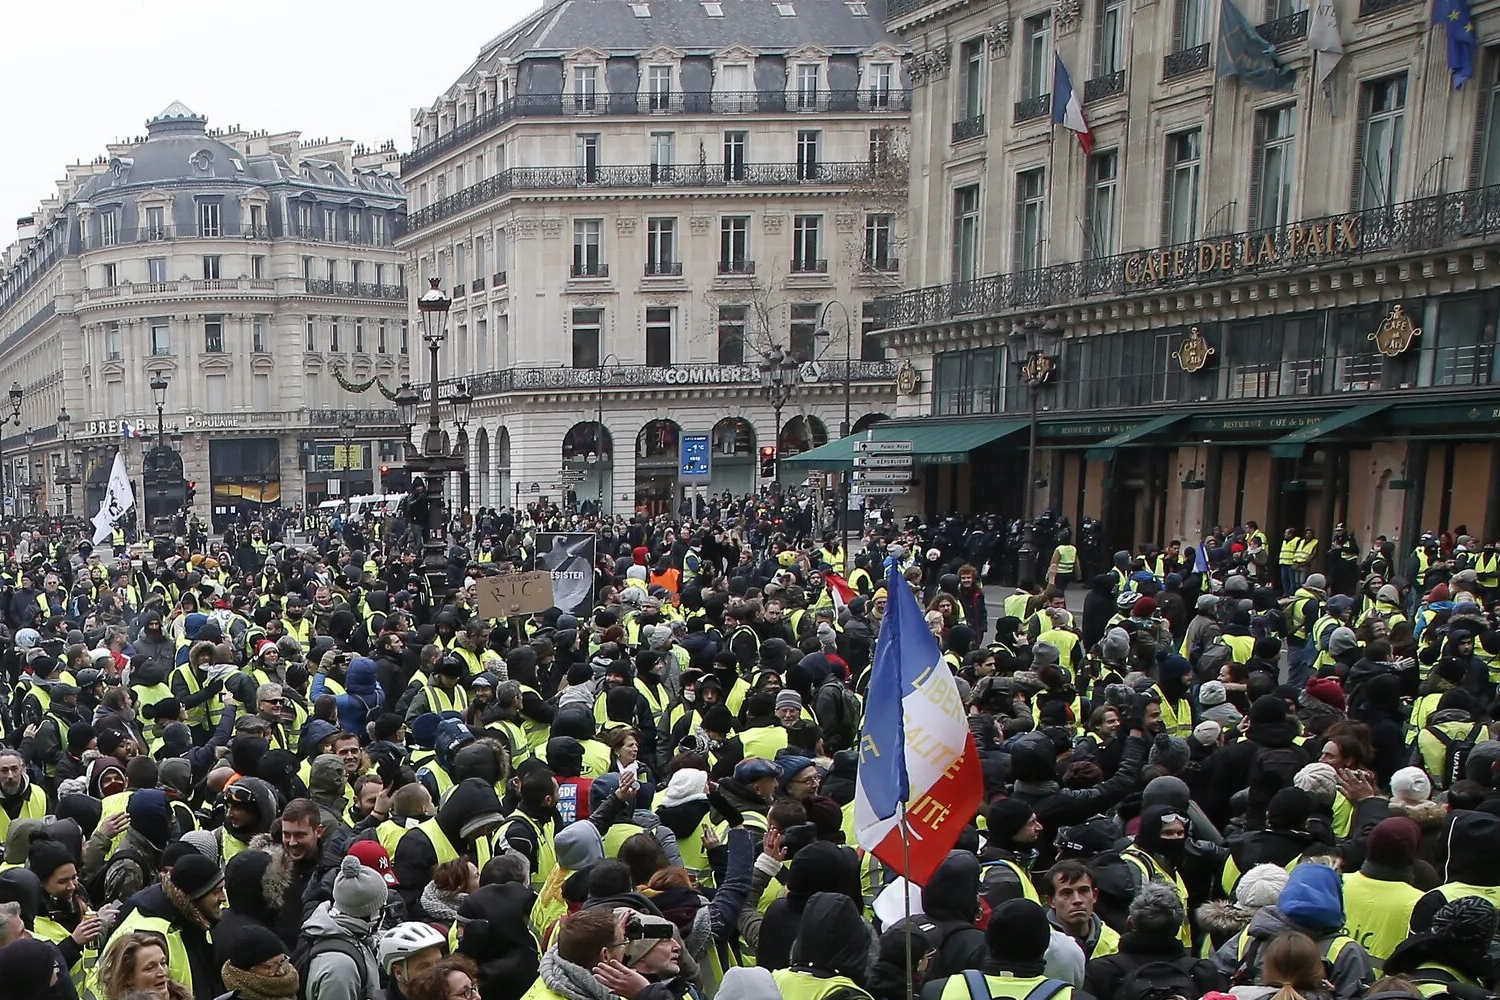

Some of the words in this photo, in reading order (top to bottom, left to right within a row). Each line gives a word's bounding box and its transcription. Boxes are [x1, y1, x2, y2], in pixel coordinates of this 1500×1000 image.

[1125, 250, 1185, 284] CAFE
[1200, 243, 1233, 273] DE
[1244, 230, 1277, 267] LA
[1290, 217, 1362, 256] PAIX
[491, 581, 533, 602] RIC
